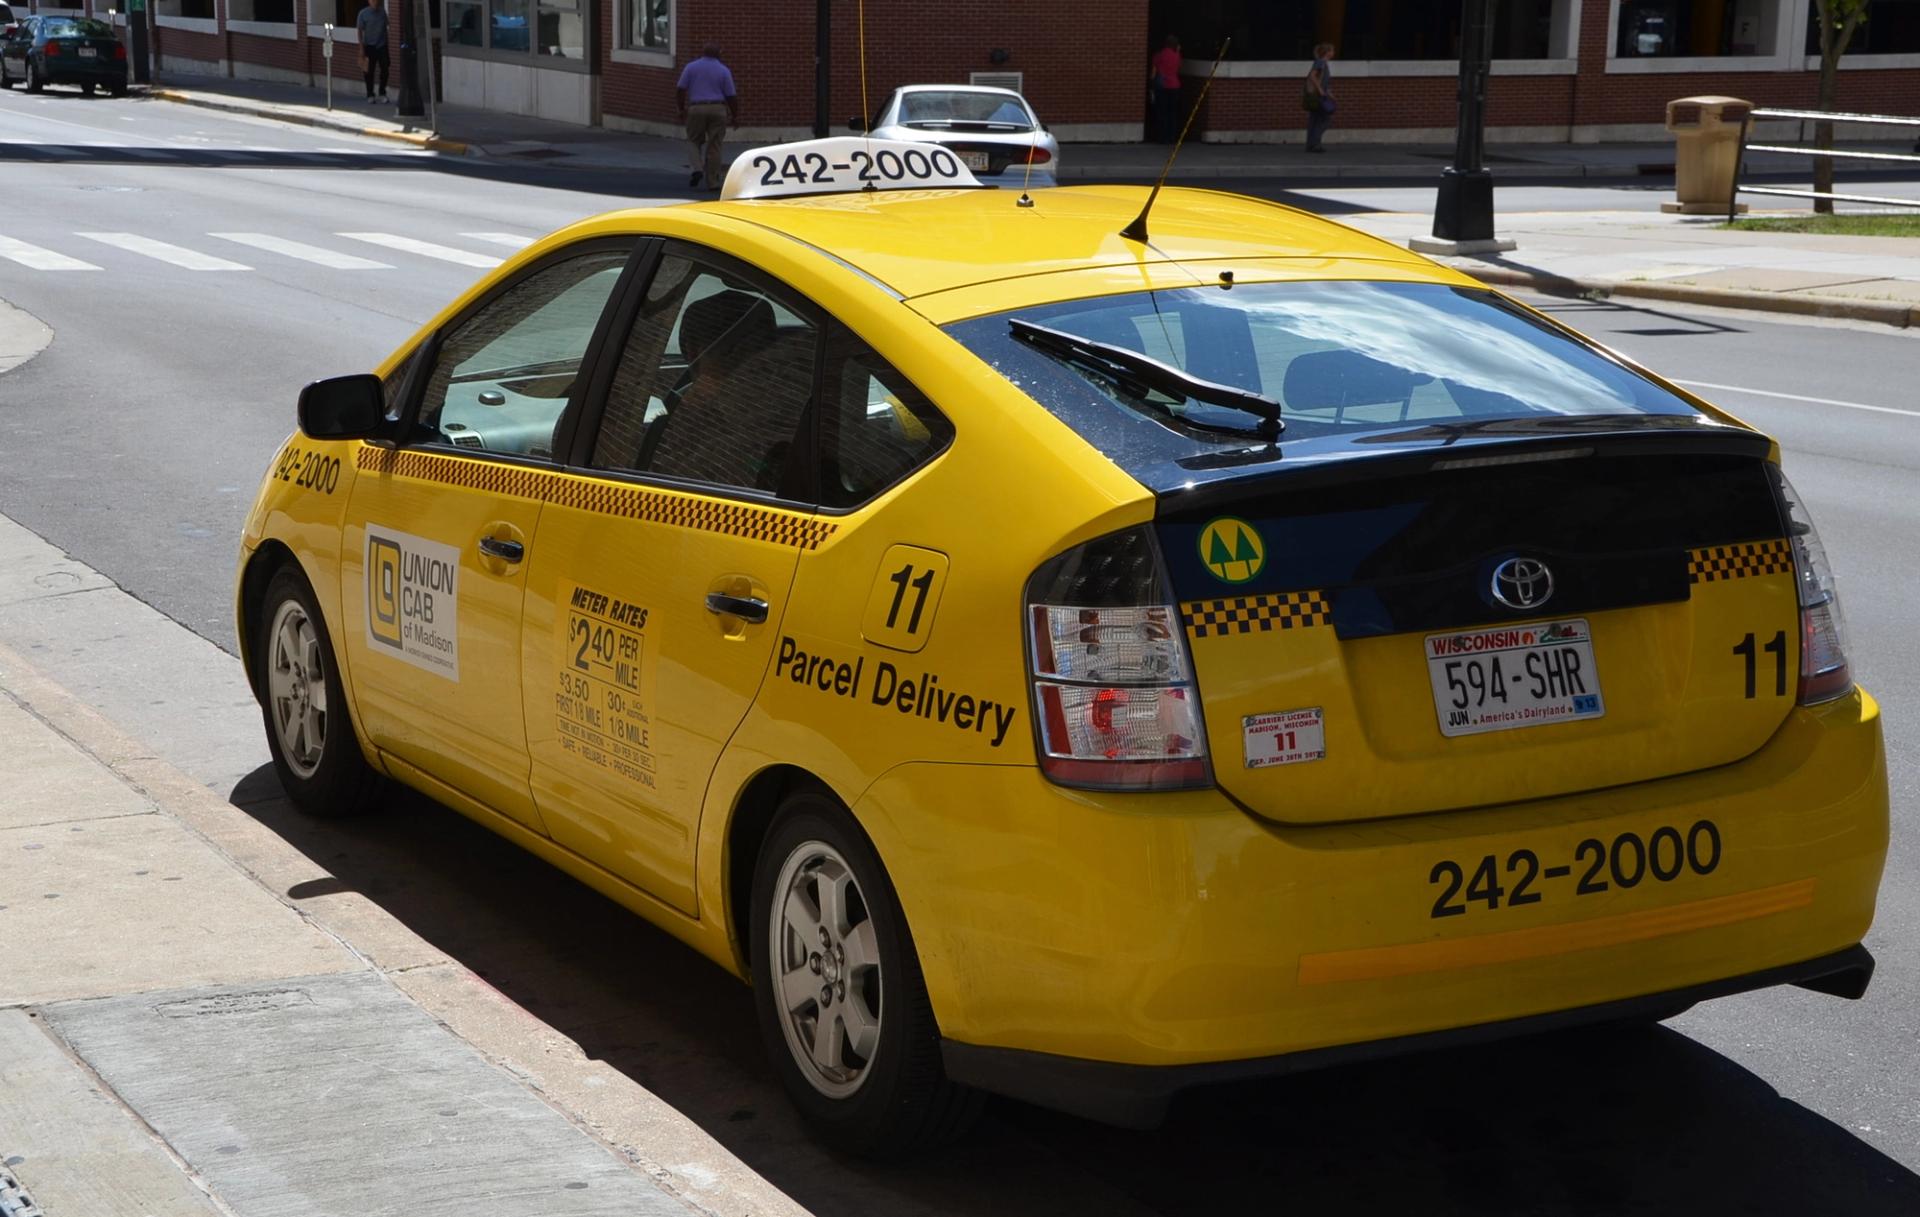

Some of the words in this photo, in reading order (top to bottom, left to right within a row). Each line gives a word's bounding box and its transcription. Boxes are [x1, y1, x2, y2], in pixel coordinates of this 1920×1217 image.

[752, 149, 959, 186] 242-2000
[273, 446, 341, 496] 242-2000
[402, 551, 455, 596] UNION
[402, 586, 435, 624] CAB
[570, 586, 609, 616] METER
[610, 599, 649, 630] RATES
[886, 563, 935, 635] 11
[403, 622, 413, 639] of
[414, 624, 454, 655] Madison
[618, 633, 639, 661] PER
[1433, 630, 1520, 656] WISCONSIN
[615, 660, 639, 690] MILE
[1445, 647, 1586, 710] 594-SHR
[1733, 630, 1786, 699] 11
[776, 636, 864, 698] Parcel
[871, 661, 1016, 747] Delivery
[1448, 710, 1470, 727] JUN
[1480, 709, 1524, 725] America's
[1525, 705, 1566, 719] Dairyland
[625, 723, 649, 749] MILE
[1274, 731, 1296, 752] 11
[1429, 819, 1721, 919] 242-2000
